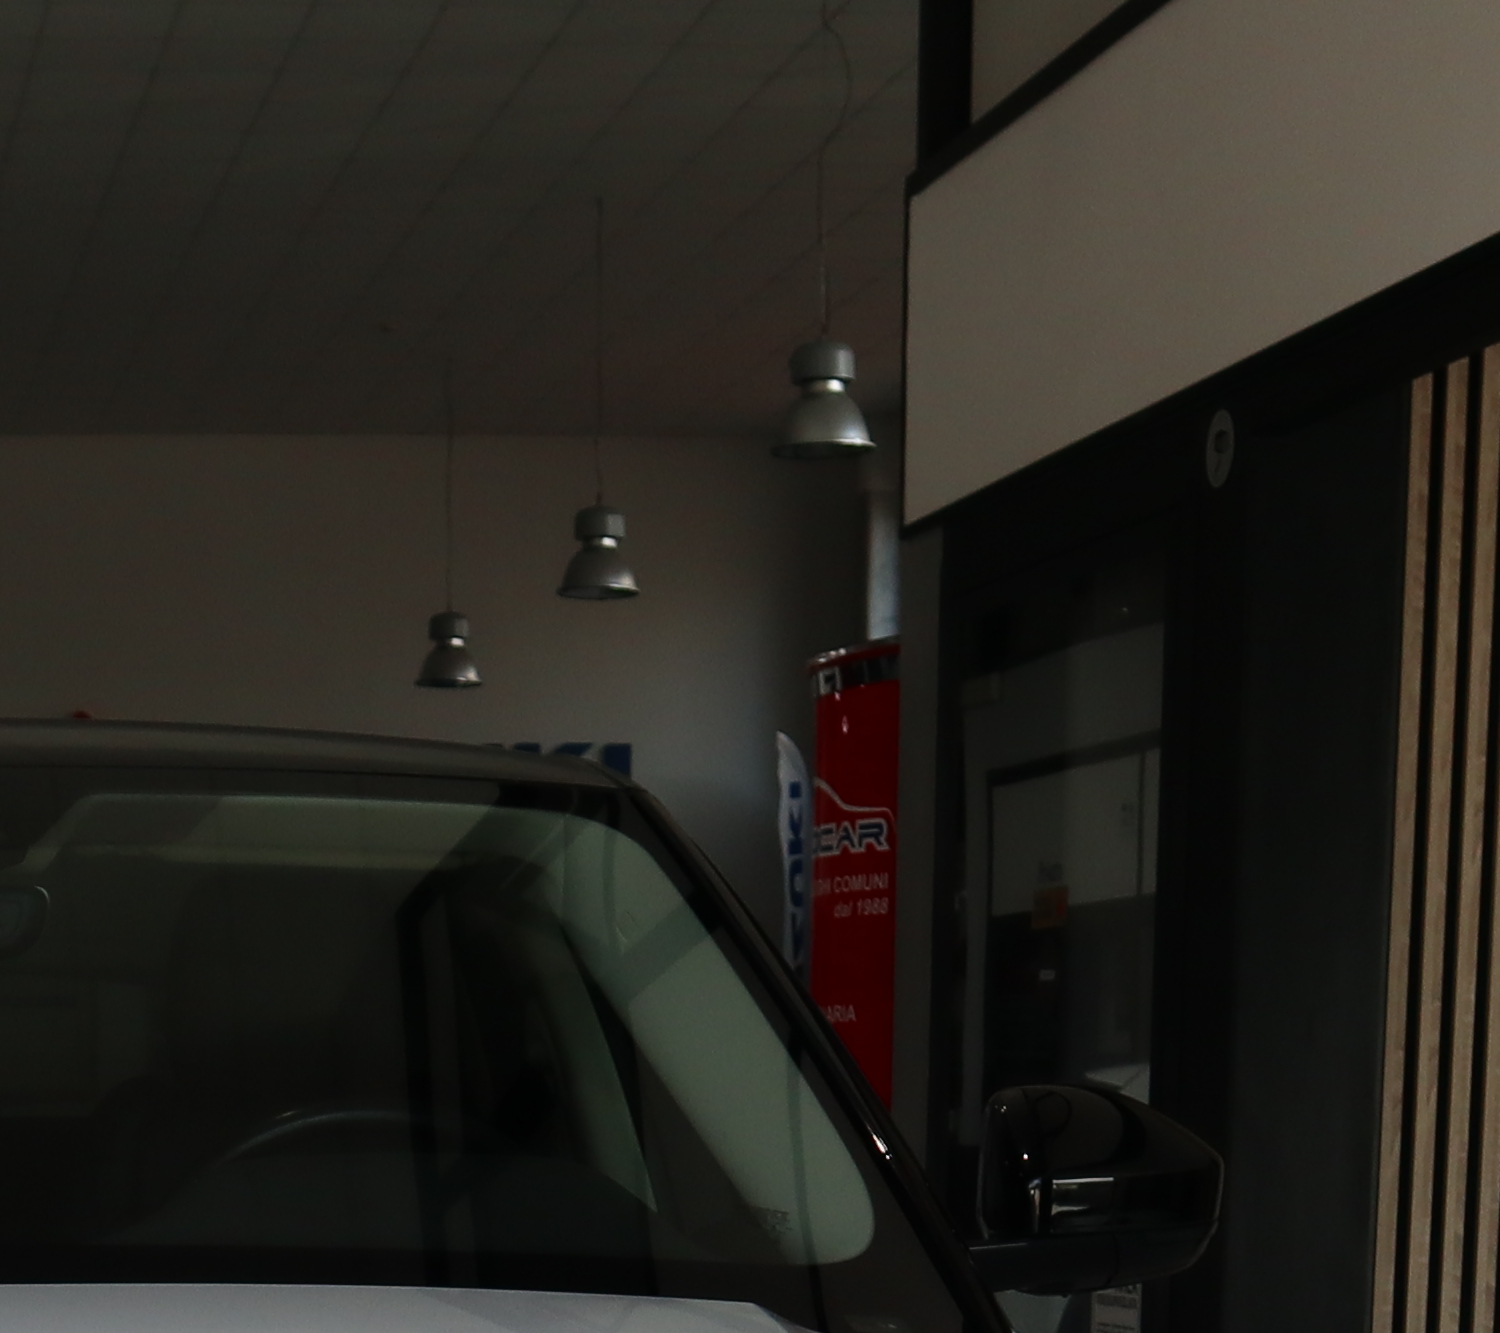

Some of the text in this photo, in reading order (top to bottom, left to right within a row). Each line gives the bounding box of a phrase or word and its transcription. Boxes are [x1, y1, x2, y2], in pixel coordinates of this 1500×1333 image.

[813, 817, 891, 857] CAR
[833, 871, 889, 895] COMUNI
[833, 896, 890, 919] dal 1988
[823, 1004, 857, 1023] ARIA
